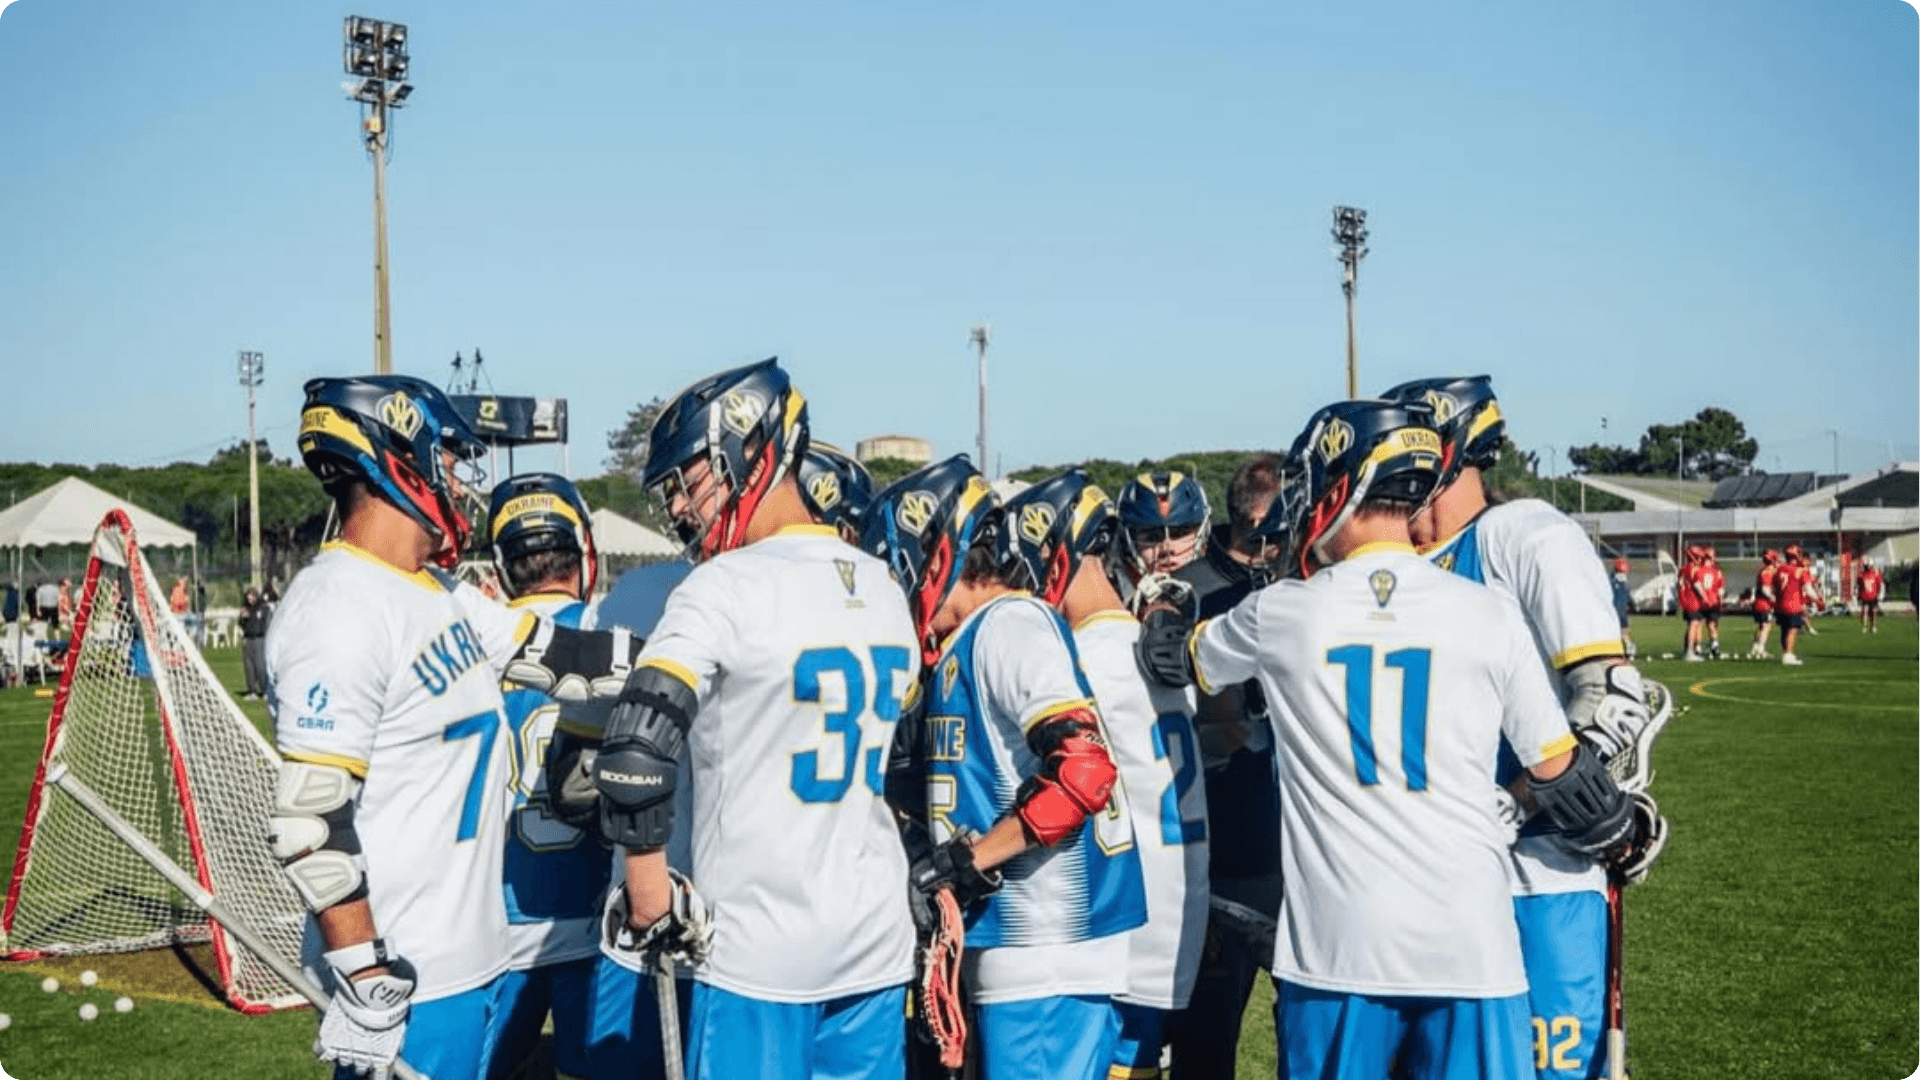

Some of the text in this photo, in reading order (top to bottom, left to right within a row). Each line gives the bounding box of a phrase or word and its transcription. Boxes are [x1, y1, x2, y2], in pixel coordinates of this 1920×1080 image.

[442, 708, 500, 844] 7
[789, 644, 911, 804] 35
[1326, 643, 1432, 792] 11
